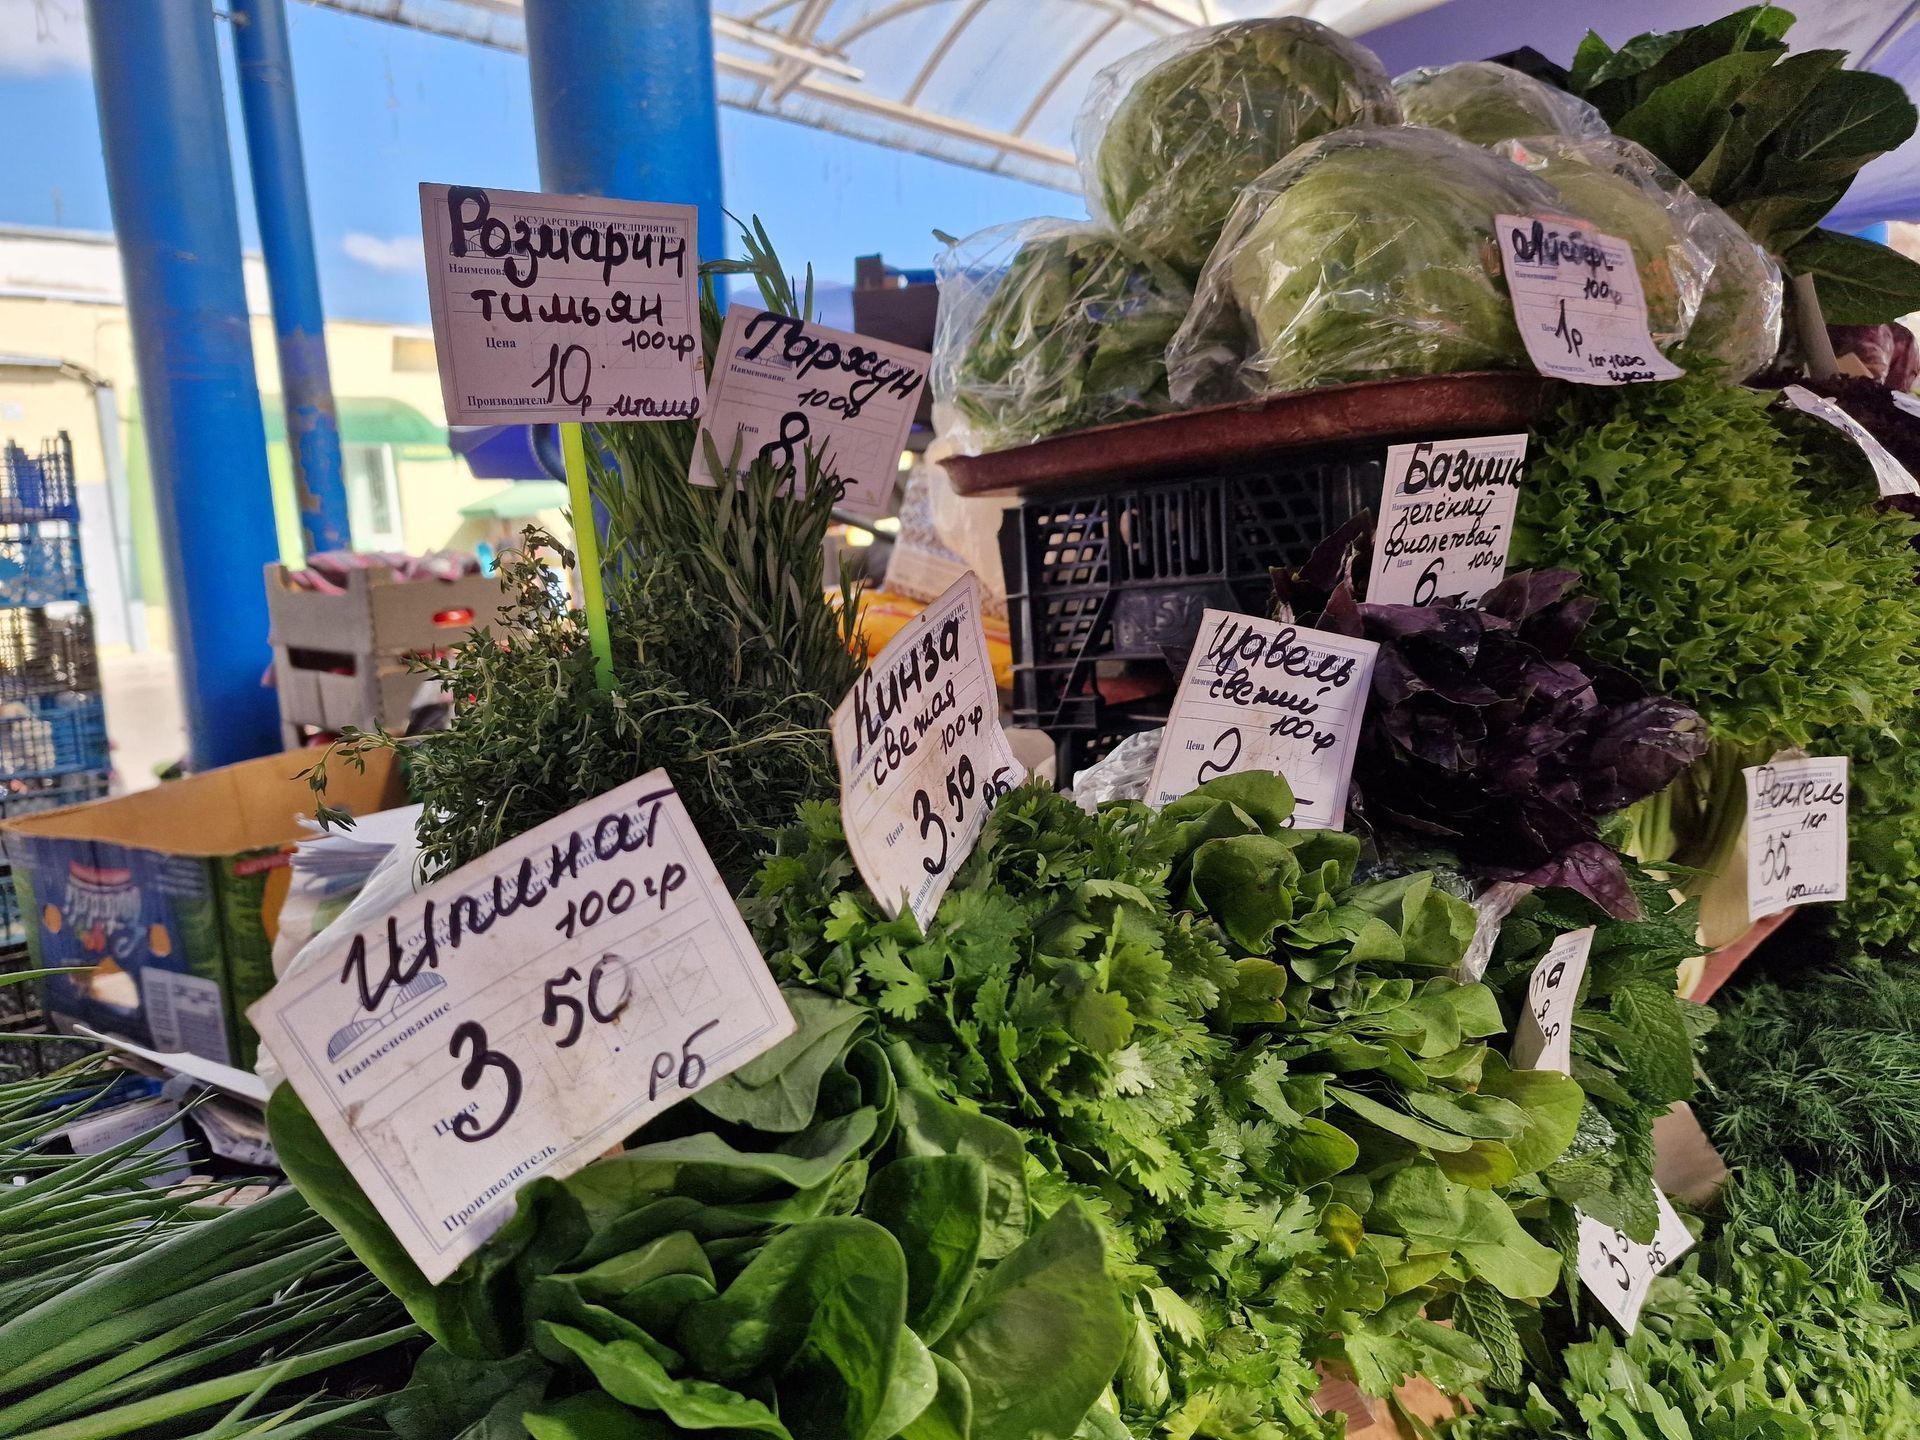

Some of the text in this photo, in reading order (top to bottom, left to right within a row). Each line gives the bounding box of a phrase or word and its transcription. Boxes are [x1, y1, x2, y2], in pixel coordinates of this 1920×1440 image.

[448, 185, 687, 288] Розмарин
[471, 289, 664, 327] тимьян
[486, 330, 696, 362] Цена 100гр
[744, 311, 923, 410] Тархун
[1403, 442, 1525, 495] Базилик
[1207, 615, 1356, 687] Щавель
[853, 616, 960, 764] Кинза
[1185, 739, 1206, 752] Цена
[885, 821, 905, 848] Цена
[336, 1000, 454, 1087] Наименование
[441, 1142, 559, 1235] Производитель
